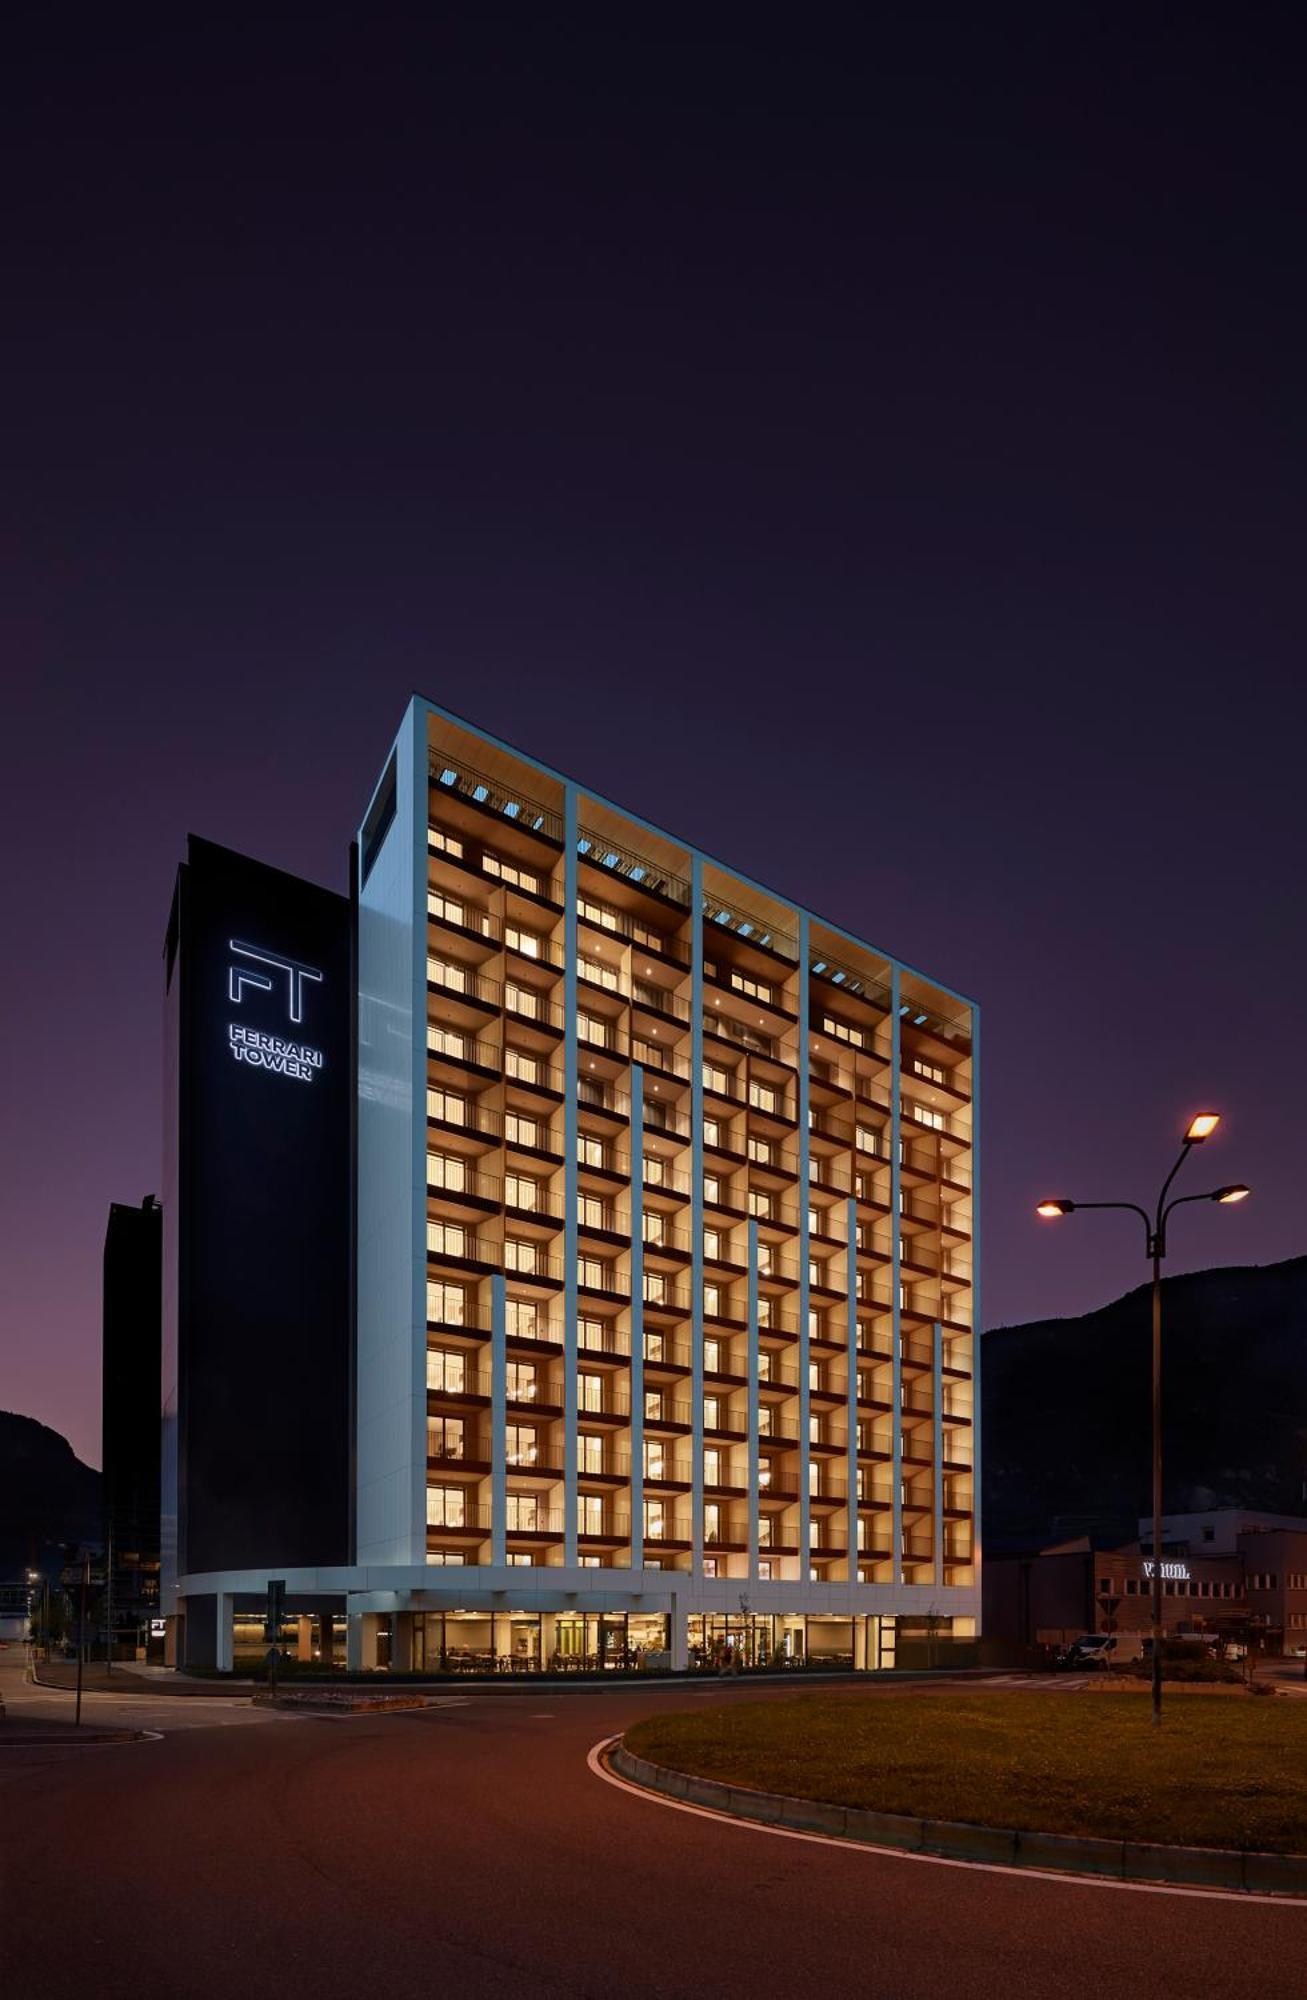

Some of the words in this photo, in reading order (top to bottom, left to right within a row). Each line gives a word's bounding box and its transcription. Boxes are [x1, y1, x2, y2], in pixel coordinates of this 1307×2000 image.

[229, 939, 323, 1022] FT
[229, 1023, 322, 1067] FERRARI
[229, 1042, 312, 1082] TOWER
